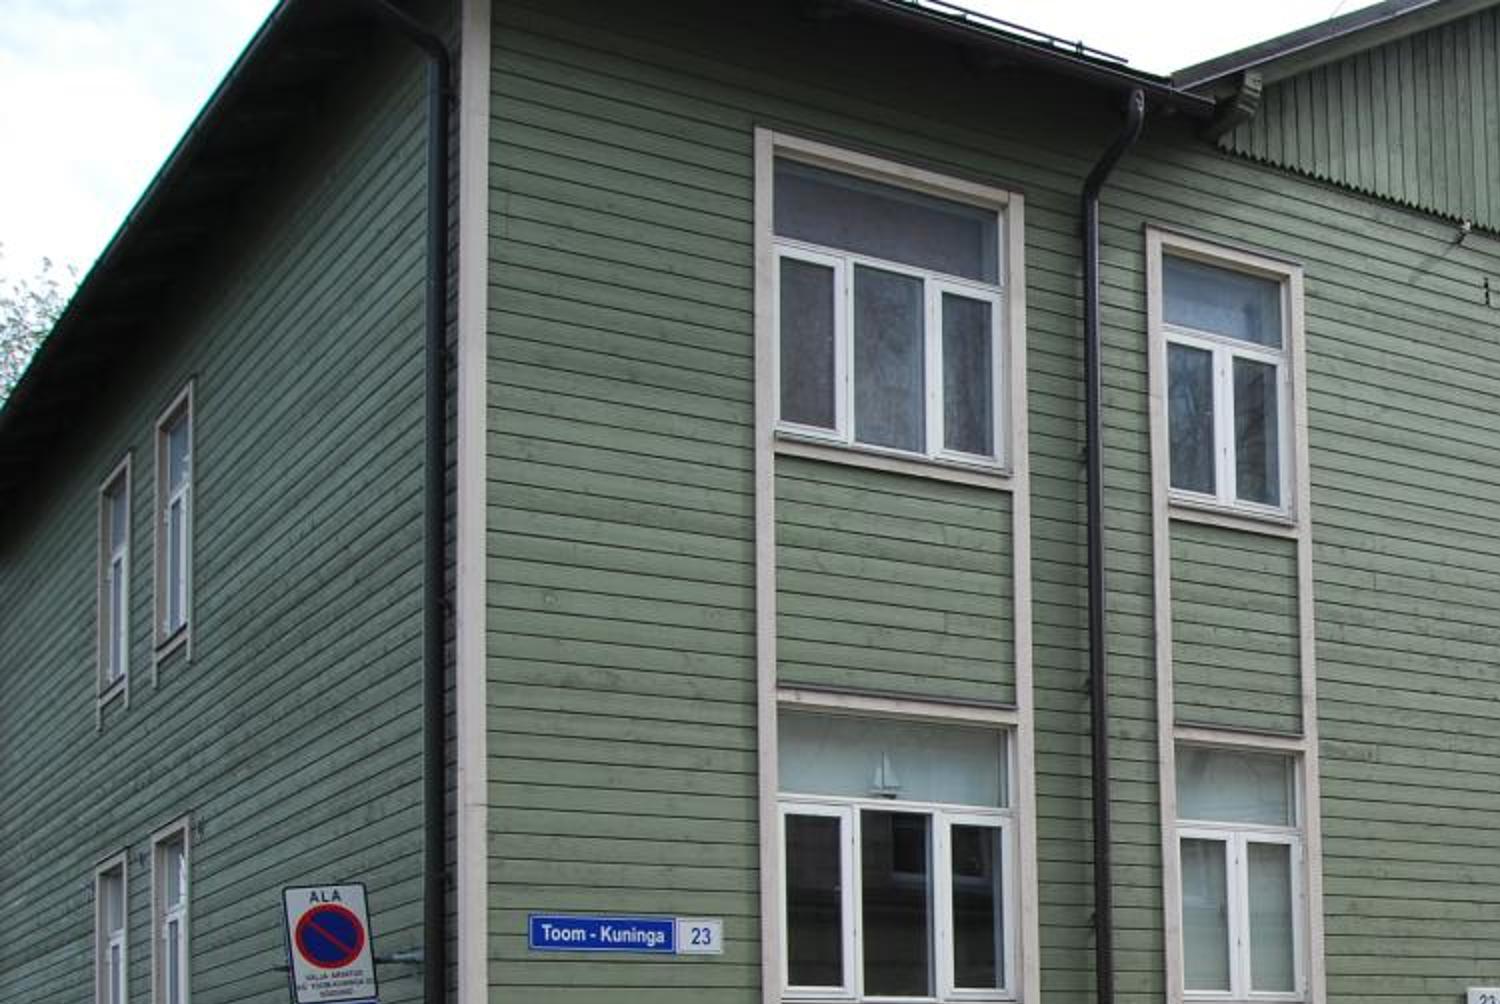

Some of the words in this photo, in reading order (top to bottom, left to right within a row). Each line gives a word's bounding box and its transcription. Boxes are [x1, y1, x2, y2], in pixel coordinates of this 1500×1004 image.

[309, 889, 341, 903] ALA
[541, 923, 587, 942] Toom
[600, 925, 665, 947] Kuninga
[690, 927, 712, 946] 23
